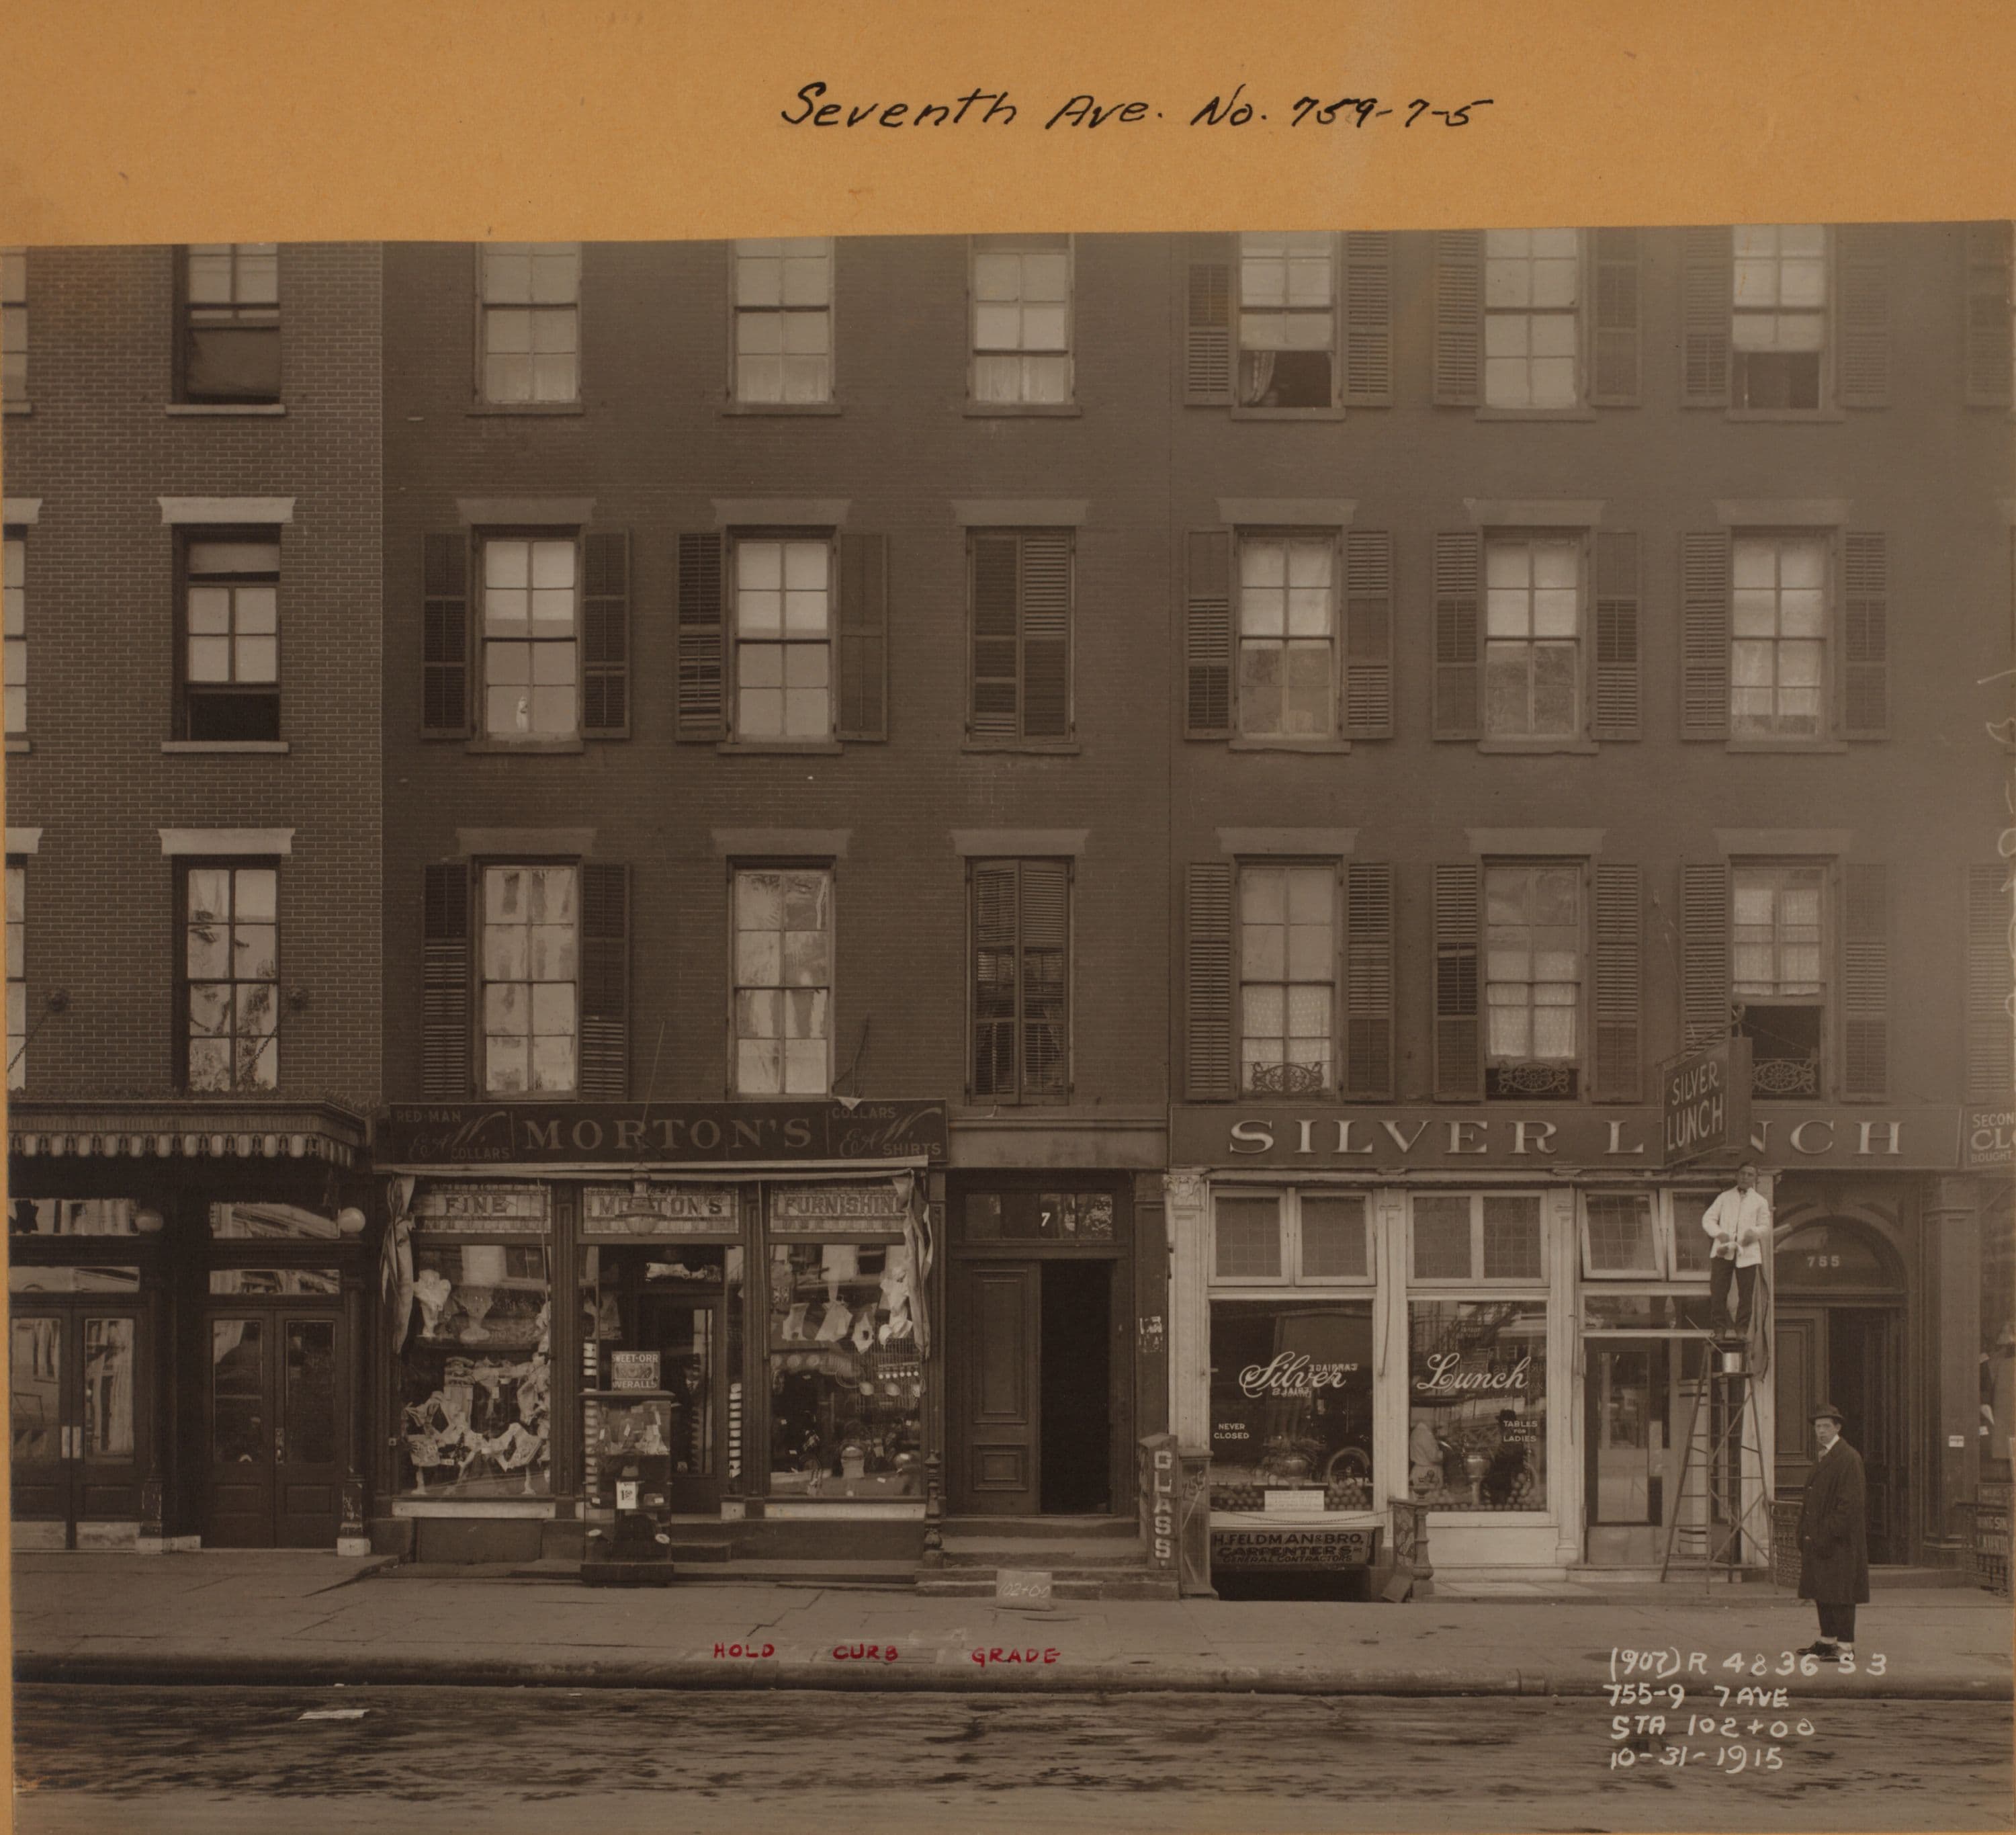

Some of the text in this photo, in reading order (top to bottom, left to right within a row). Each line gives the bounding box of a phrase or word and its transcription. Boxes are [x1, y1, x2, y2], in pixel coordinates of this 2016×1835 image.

[1671, 1061, 1720, 1107] SILVER
[832, 1107, 895, 1119] COLLARS
[1667, 1093, 1723, 1152] LUNCH
[525, 1118, 812, 1150] MORTON'S
[1229, 1119, 1902, 1154] SILVER LCH
[451, 1148, 510, 1160] COLLARS
[883, 1143, 941, 1156] SHIRTS
[1972, 1150, 2014, 1163] BOUGHT
[445, 1196, 508, 1214] FINE
[599, 1197, 722, 1215] MTON'S
[1807, 1256, 1840, 1268] 755
[612, 1354, 658, 1363] SWEET-ORR
[1239, 1351, 1346, 1398] Silver
[1416, 1353, 1532, 1393] Lunch
[1217, 1545, 1352, 1557] CARPENTERS
[1223, 1554, 1353, 1564] GENERAL CONTRACTORS
